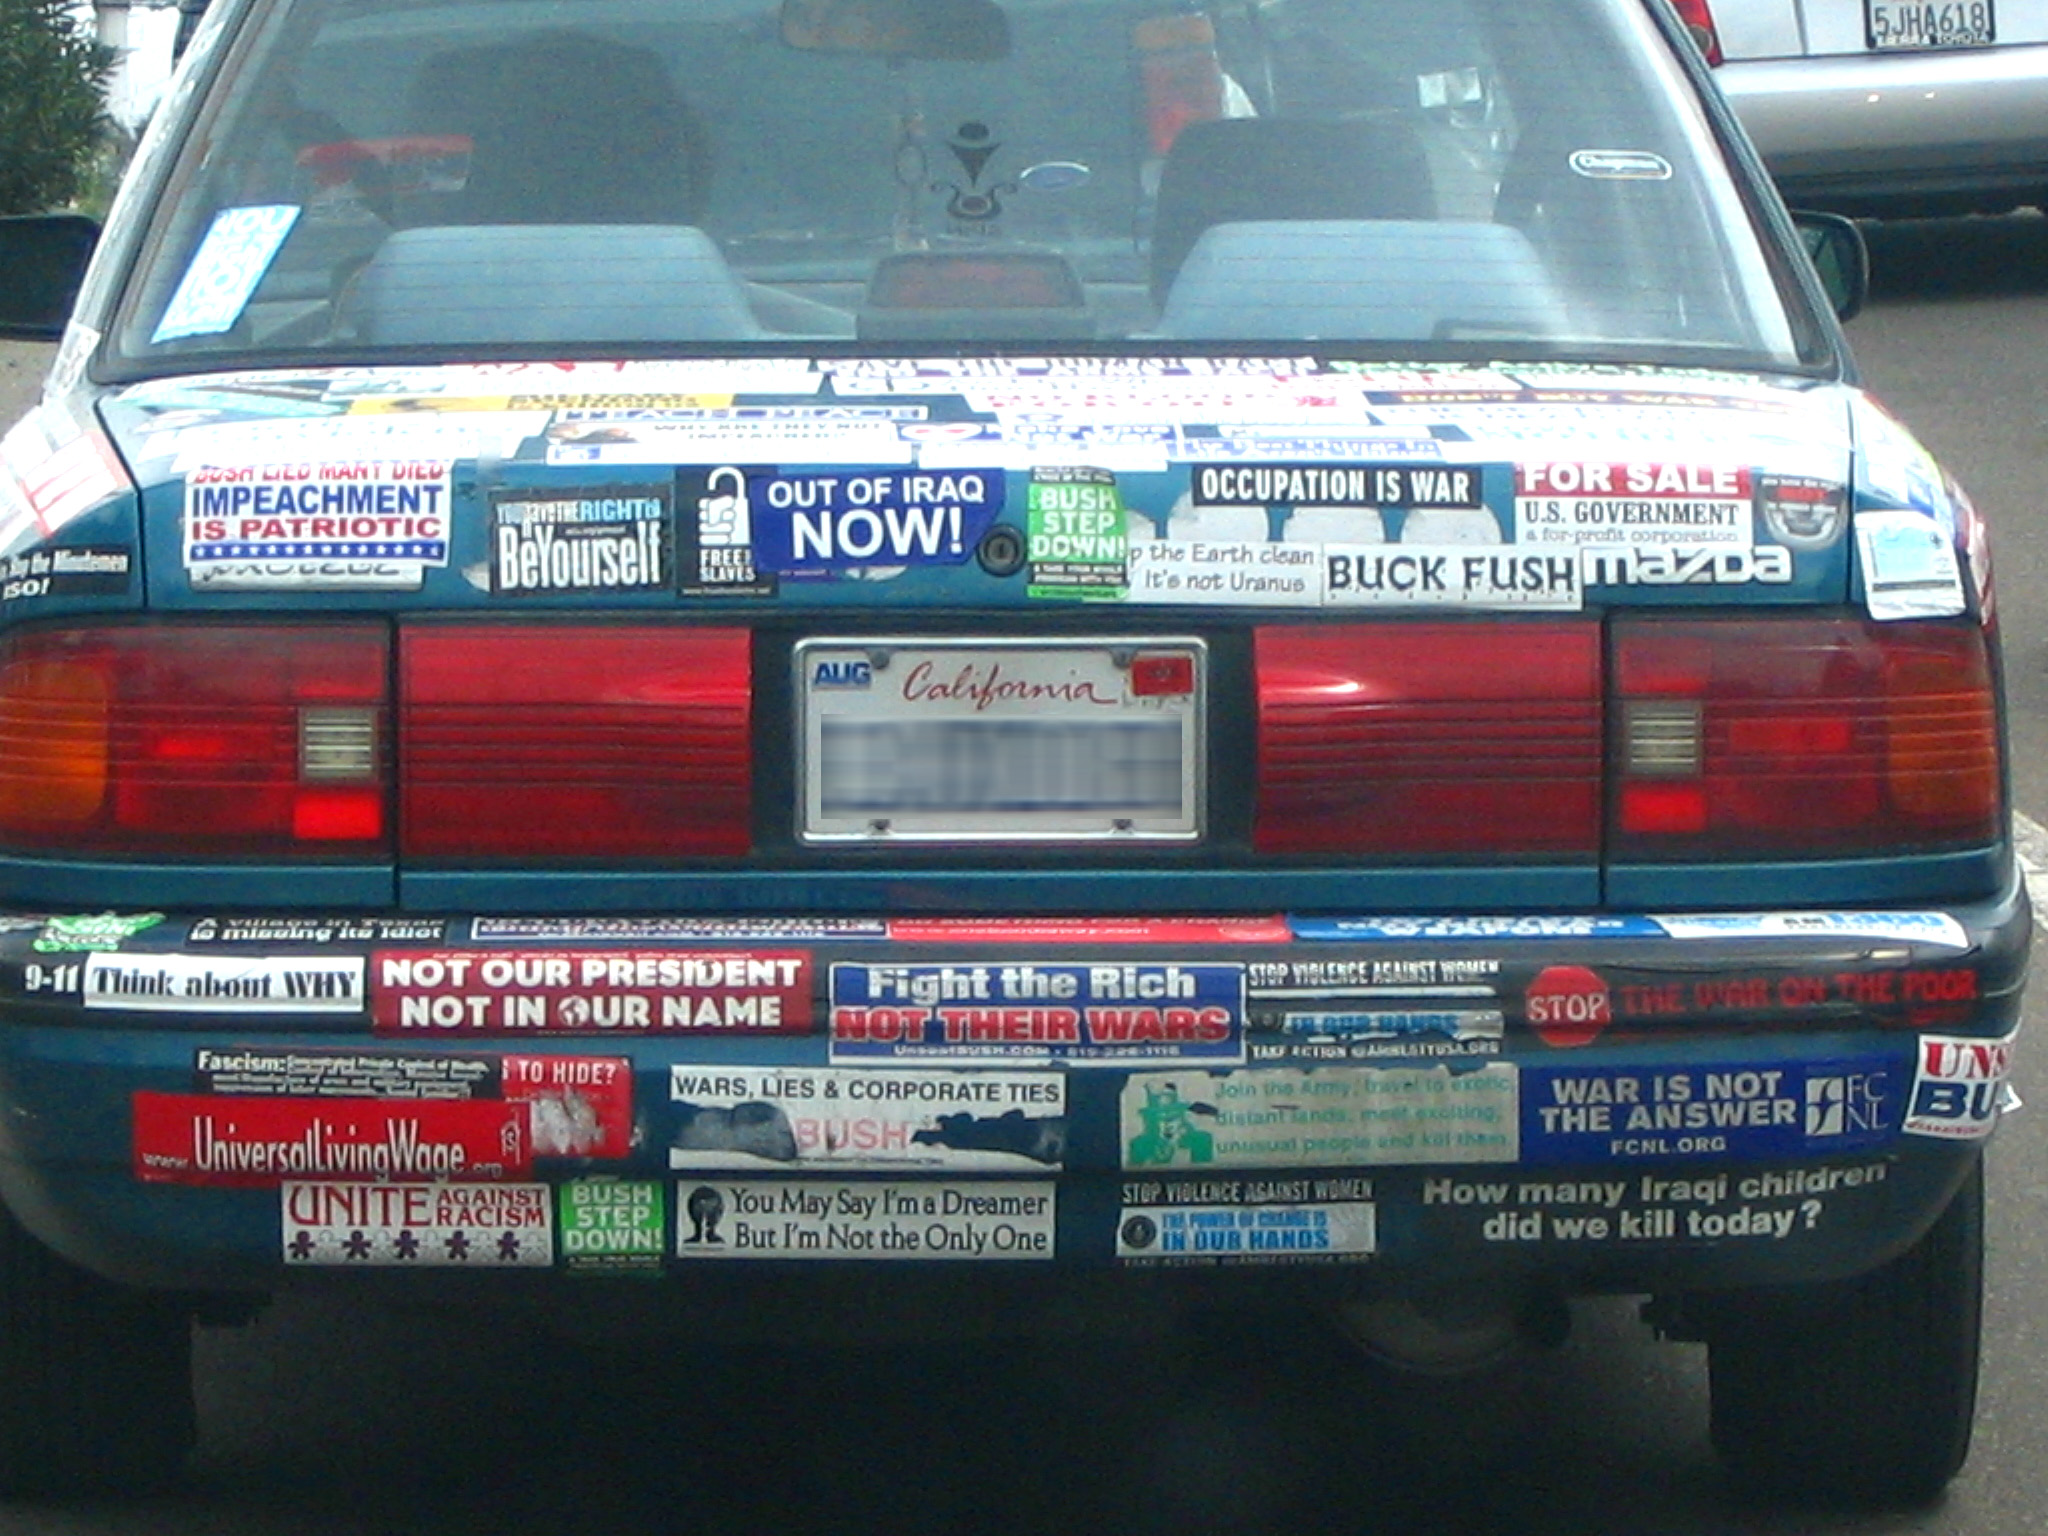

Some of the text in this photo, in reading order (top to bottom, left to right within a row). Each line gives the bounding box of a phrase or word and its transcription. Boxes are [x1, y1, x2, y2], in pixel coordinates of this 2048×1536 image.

[1875, 3, 1985, 37] 5JHA618
[768, 475, 985, 508] OUT OF IRAQ
[1203, 468, 1470, 502] OCCUPATION IS WAR
[1522, 463, 1739, 494] FOR SALE
[193, 484, 443, 517] IMPEACHMENT
[1040, 488, 1116, 510] BUSH
[1525, 500, 1741, 527] U.S. GOVERNMENT
[193, 518, 441, 540] IS PATRIOTIC
[791, 506, 962, 560] NOW!
[1043, 511, 1115, 534] STEP
[1543, 526, 1624, 545] for-profit
[1631, 528, 1738, 545] corporation
[500, 521, 661, 589] BeYourself
[1033, 535, 1125, 559] DOWN!
[1150, 543, 1314, 564] the Earth clean
[1146, 570, 1306, 592] It's not Uranus
[1328, 554, 1575, 592] BUCK FUSH
[814, 661, 872, 686] AUG
[903, 661, 1118, 711] California
[26, 964, 78, 993] 9-11
[93, 966, 357, 999] Think about WHY
[382, 957, 802, 988] NOT OUR PRESIDENT
[868, 966, 1197, 1005] Fight the Rich
[1249, 963, 1289, 986] STOP
[1291, 961, 1369, 985] VIOLENCE
[1372, 960, 1437, 984] AGAINST
[1622, 984, 1685, 1015] THE
[1780, 975, 1826, 1006] ON
[1836, 971, 1896, 1002] THE
[1904, 969, 1978, 1001] POOR
[401, 995, 491, 1028] NOT
[504, 996, 546, 1027] IN
[662, 995, 783, 1028] NAME
[1528, 994, 1606, 1023] STOP
[833, 1006, 1230, 1044] NOT THEIR WARS
[199, 1051, 286, 1072] Fascism:
[517, 1060, 544, 1083] TO
[552, 1061, 617, 1085] HIDE?
[676, 1078, 1060, 1102] WARS, LIES & CORPORATE TIES
[1215, 1081, 1256, 1099] Join
[1264, 1080, 1293, 1096] the
[1552, 1072, 1782, 1105] WAR IS NOT
[1847, 1072, 1888, 1103] FC
[1215, 1110, 1284, 1126] distant
[1360, 1107, 1409, 1121] meet
[1540, 1101, 1797, 1133] THE ANSWER
[1847, 1101, 1889, 1132] NL
[193, 1115, 467, 1182] UniversalLivingWage
[798, 1118, 909, 1151] BUSH
[1303, 1136, 1370, 1155] people
[1377, 1133, 1414, 1148] and
[1610, 1137, 1726, 1155] FCNL.ORG
[572, 1184, 653, 1204] BUSH
[1122, 1179, 1373, 1203] STOP VIOLENCE AGAINST WOMEN
[1423, 1162, 1888, 1209] How many Iraqi children
[288, 1184, 545, 1227] UNITE AGAINST
[436, 1207, 546, 1228] RACISM
[576, 1206, 650, 1228] STEP
[730, 1187, 1048, 1220] You May Say I'm a Dreamer
[566, 1228, 662, 1251] DOWN!
[735, 1223, 1047, 1255] But I'm Not the Only One
[1162, 1228, 1329, 1251] IN OUR HANDS
[1484, 1213, 1542, 1241] did
[1552, 1217, 1610, 1240] we
[1620, 1211, 1676, 1239] kill
